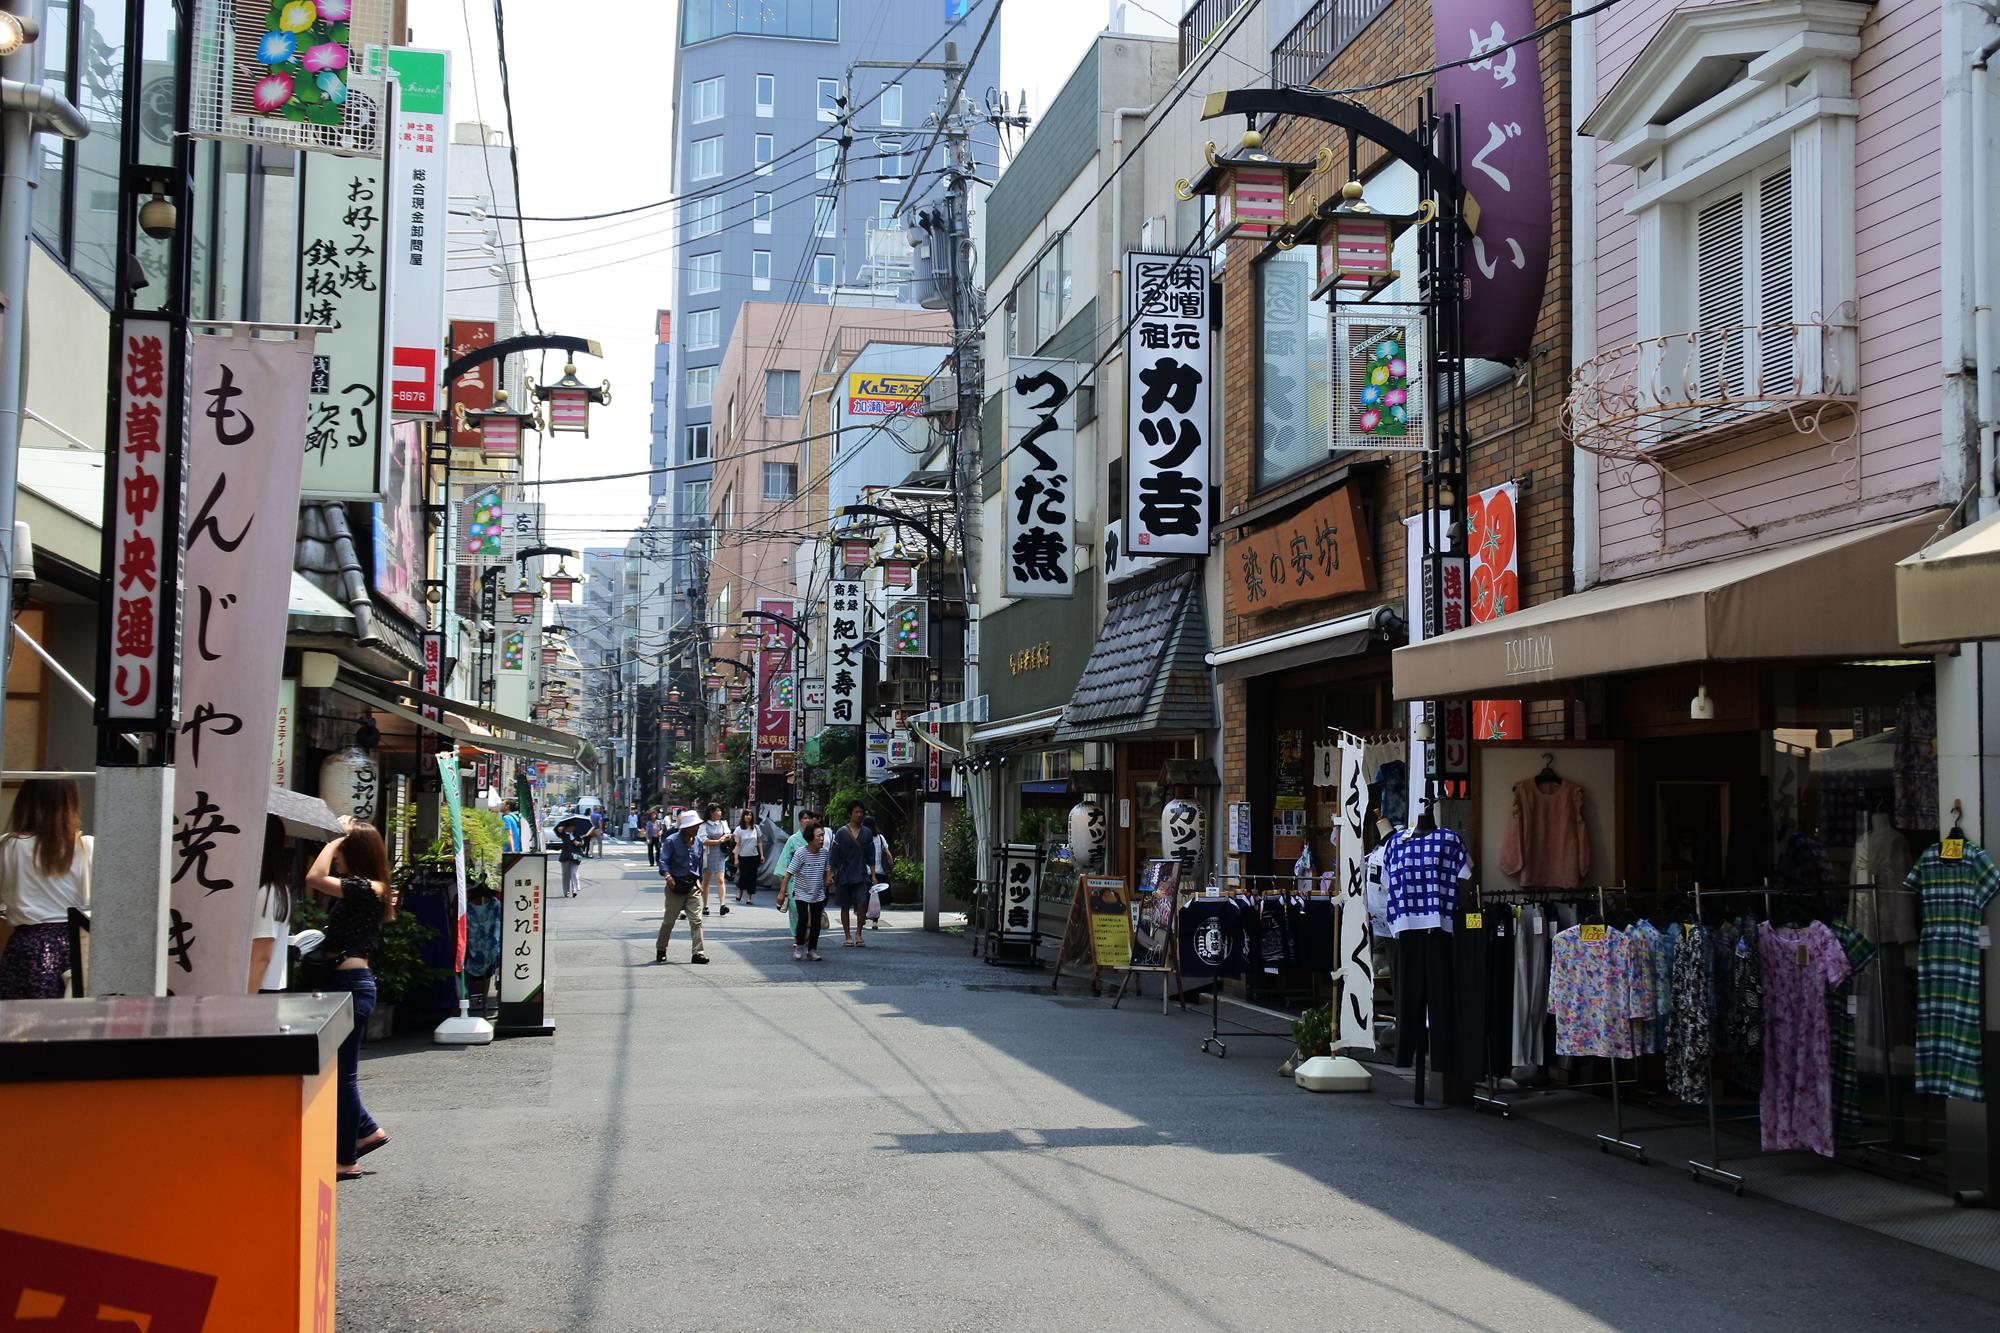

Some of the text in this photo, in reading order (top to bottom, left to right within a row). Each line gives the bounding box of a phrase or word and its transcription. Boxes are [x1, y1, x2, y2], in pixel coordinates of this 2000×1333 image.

[339, 175, 379, 292] お好み焼
[409, 168, 427, 267] 総合現金卸問屋
[303, 238, 342, 330] 鉄板焼
[1168, 268, 1202, 316] 味噌
[1012, 371, 1069, 584] つくだ煮
[1138, 357, 1203, 537] カツ吉
[114, 335, 162, 706] 浅草中央通り
[1505, 636, 1554, 672] TSUTAYA
[1007, 862, 1032, 929] カツ吉
